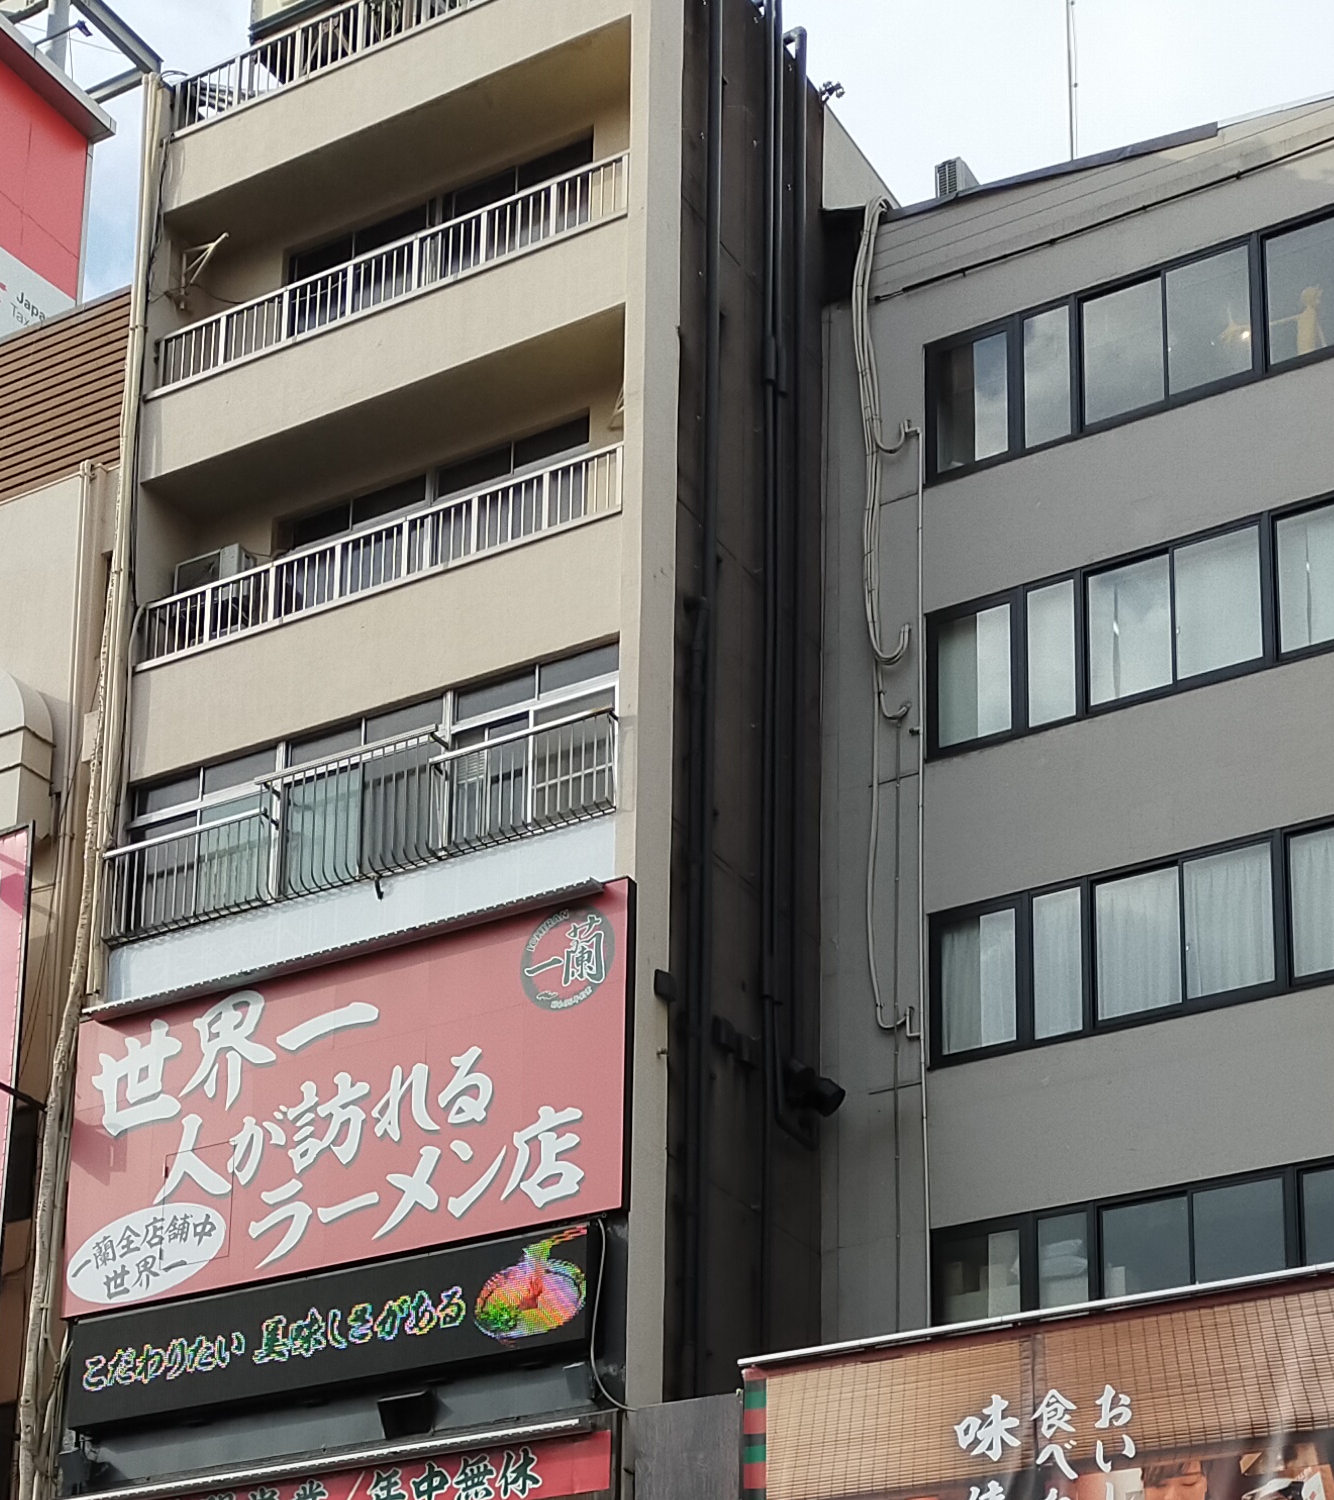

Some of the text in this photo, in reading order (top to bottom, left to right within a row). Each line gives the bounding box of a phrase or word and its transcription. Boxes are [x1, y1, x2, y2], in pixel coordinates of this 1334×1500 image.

[14, 291, 51, 322] Japa
[524, 914, 606, 987] 一蘭
[526, 909, 570, 952] ICHIRAN
[91, 990, 380, 1138] 世界一
[153, 1046, 494, 1205] 人が訪れる
[248, 1105, 586, 1270] ラーメン店
[70, 1213, 217, 1279] 一蘭全店舗中
[103, 1255, 189, 1301] 世界一
